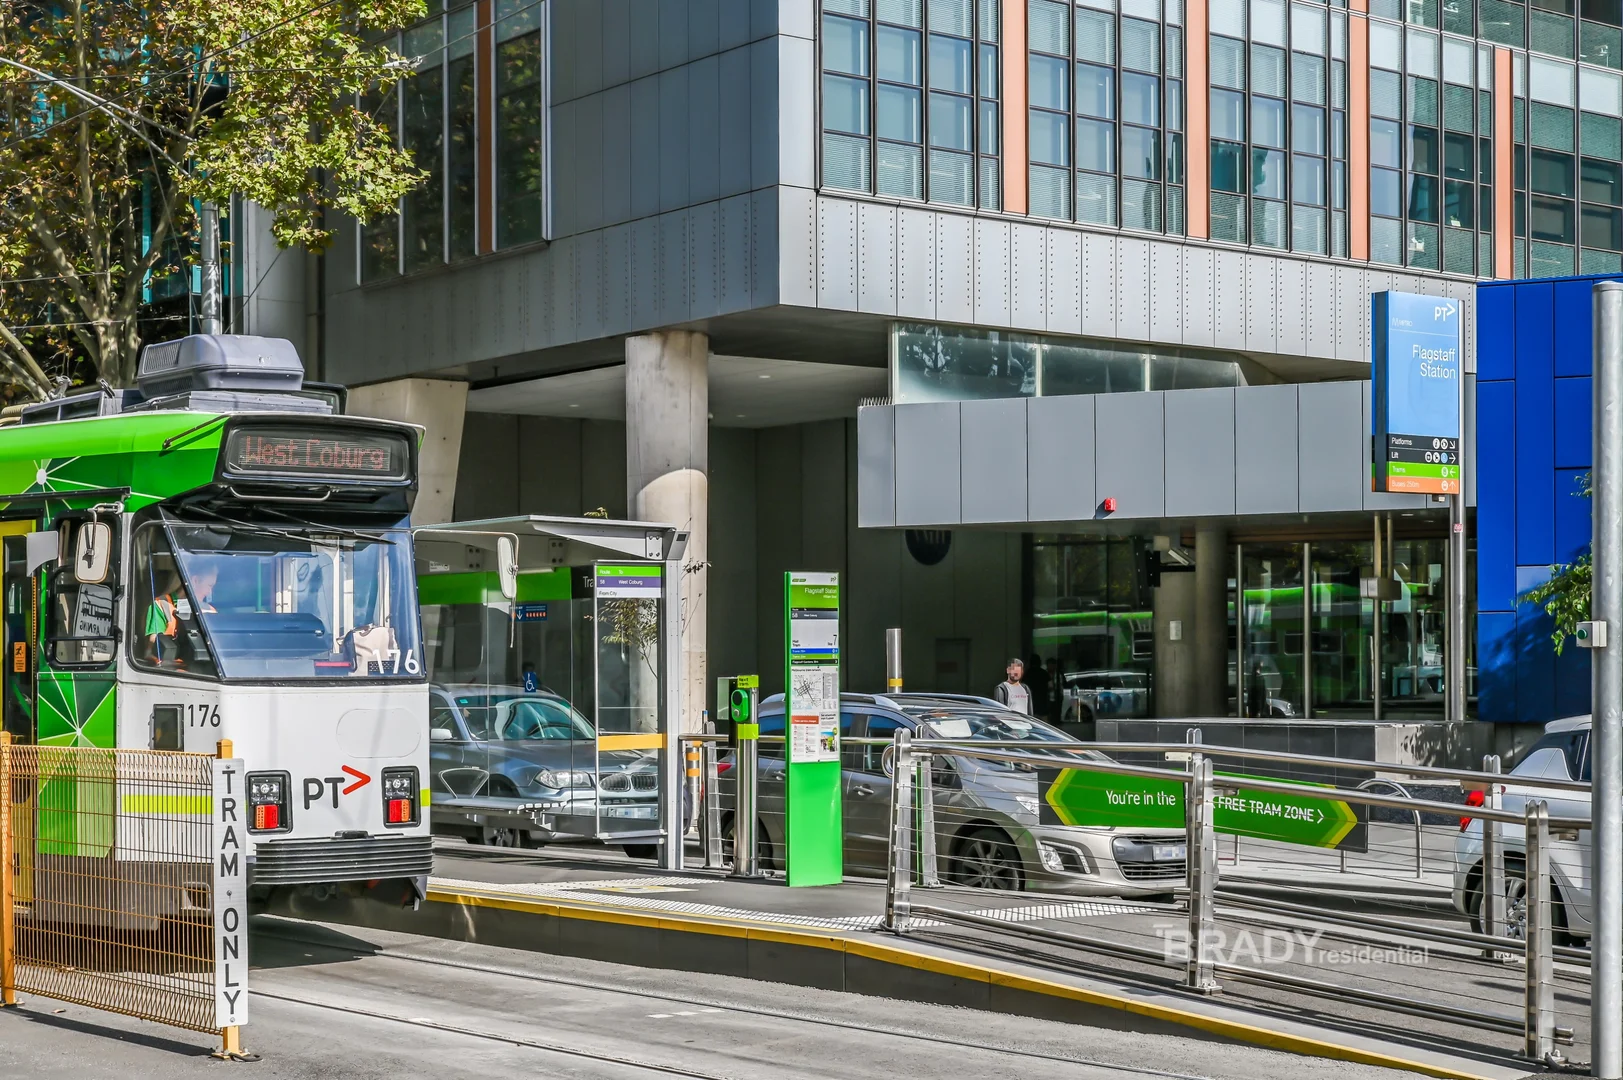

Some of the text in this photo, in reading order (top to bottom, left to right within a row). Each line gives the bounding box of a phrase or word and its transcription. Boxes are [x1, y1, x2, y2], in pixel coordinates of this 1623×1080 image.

[1412, 344, 1456, 363] Flagstaff
[1420, 362, 1456, 379] Station
[1391, 437, 1413, 446] Platforms
[245, 435, 384, 470] West Coburg
[1391, 451, 1399, 459] Lift
[1392, 465, 1406, 473] Trams
[804, 587, 824, 595] Flagstaff
[372, 649, 420, 675] 176
[188, 704, 221, 728] 176
[1106, 790, 1314, 822] You're in the FREE TRAM ZONE
[220, 770, 242, 1015] TRAM ONLY
